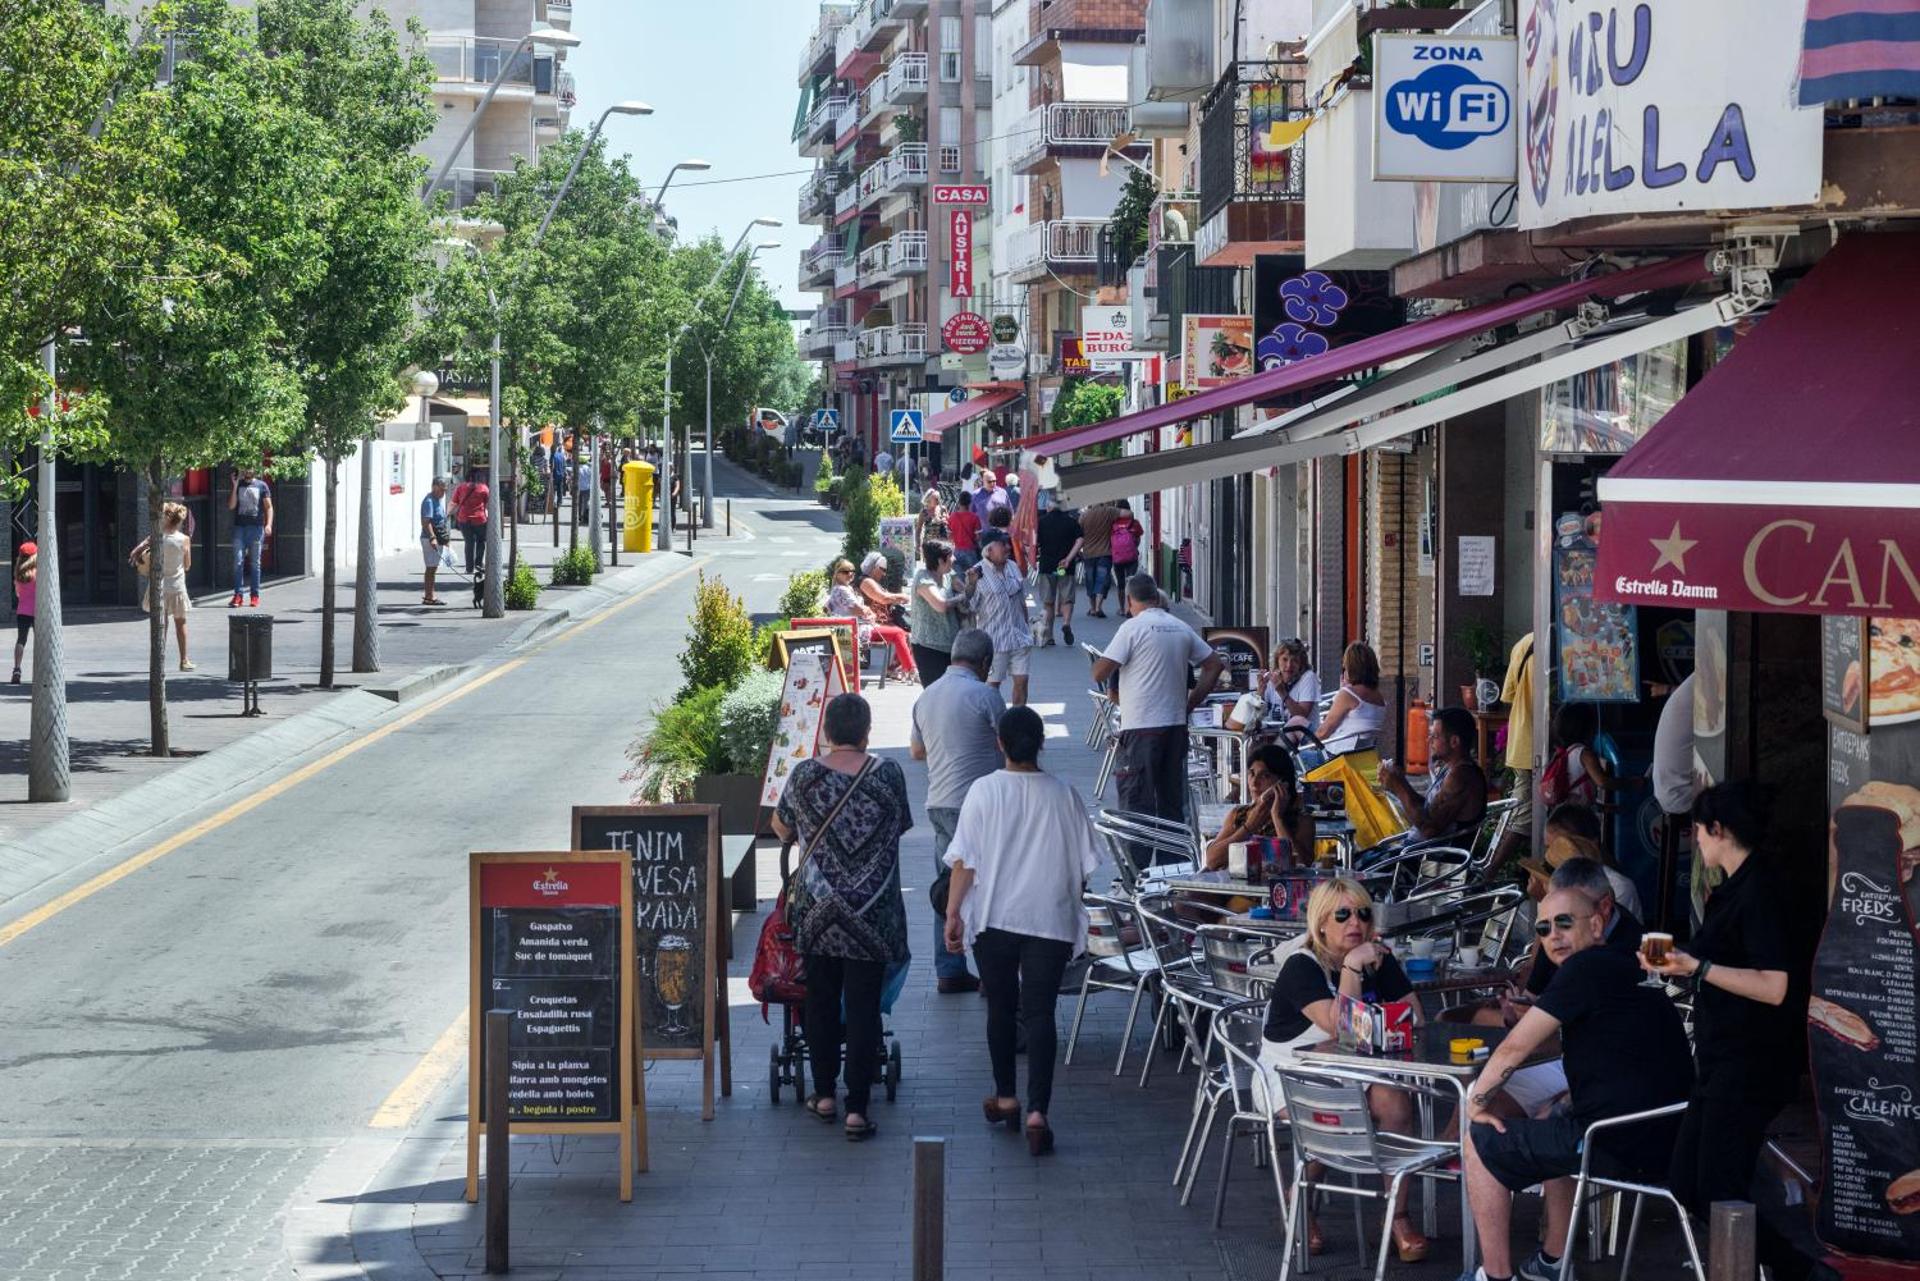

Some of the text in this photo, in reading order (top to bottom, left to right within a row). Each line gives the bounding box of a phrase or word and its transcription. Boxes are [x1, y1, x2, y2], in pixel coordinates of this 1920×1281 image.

[1413, 46, 1484, 61] ZONA
[936, 189, 986, 201] CASA
[955, 212, 967, 296] AUSTRIA
[945, 314, 989, 338] RESTAURANT
[1103, 332, 1124, 341] DA
[1615, 575, 1718, 599] Estrella Damm
[606, 830, 684, 861] TENIM
[533, 880, 568, 891] Estrella
[1841, 898, 1894, 917] FREDS
[529, 921, 573, 932] Gaspatxo
[519, 936, 589, 947] Amanida verda
[514, 951, 593, 962] Suc de tomàquet
[529, 995, 578, 1006] Croquetas
[517, 1010, 592, 1019] Ensaladilla rusa
[526, 1024, 581, 1035] Espaguettis
[547, 1061, 556, 1070] la
[558, 1061, 590, 1071] planxa
[539, 1075, 560, 1084] amb
[562, 1075, 608, 1085] mongetes
[543, 1090, 563, 1099] amb
[566, 1090, 595, 1099] bolets
[523, 1105, 558, 1116] beguda
[566, 1106, 596, 1115] postre
[1849, 1097, 1920, 1120] CALENTS
